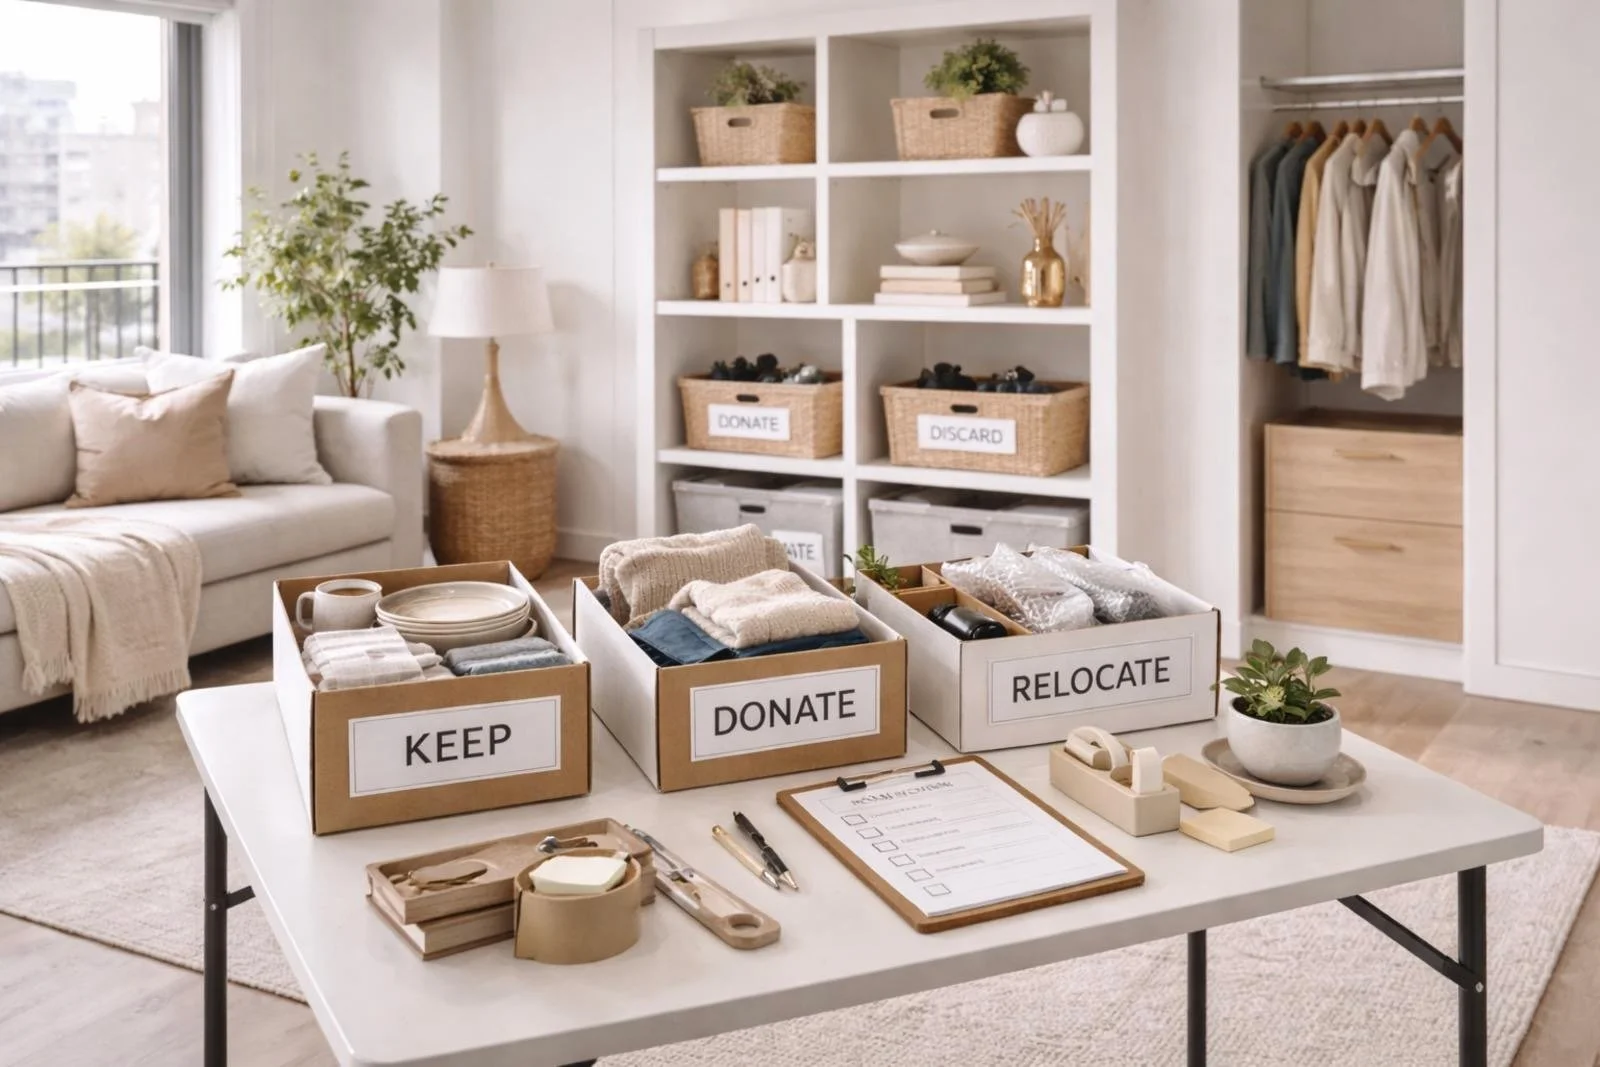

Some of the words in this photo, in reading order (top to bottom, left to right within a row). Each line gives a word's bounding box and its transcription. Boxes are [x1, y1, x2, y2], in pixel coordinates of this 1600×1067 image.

[718, 413, 779, 432] DONATE
[929, 424, 1004, 445] DISCARD
[784, 542, 815, 560] ATE
[1012, 656, 1171, 704] RELOCATE
[713, 688, 857, 737] DONATE
[405, 723, 512, 766] KEEP
